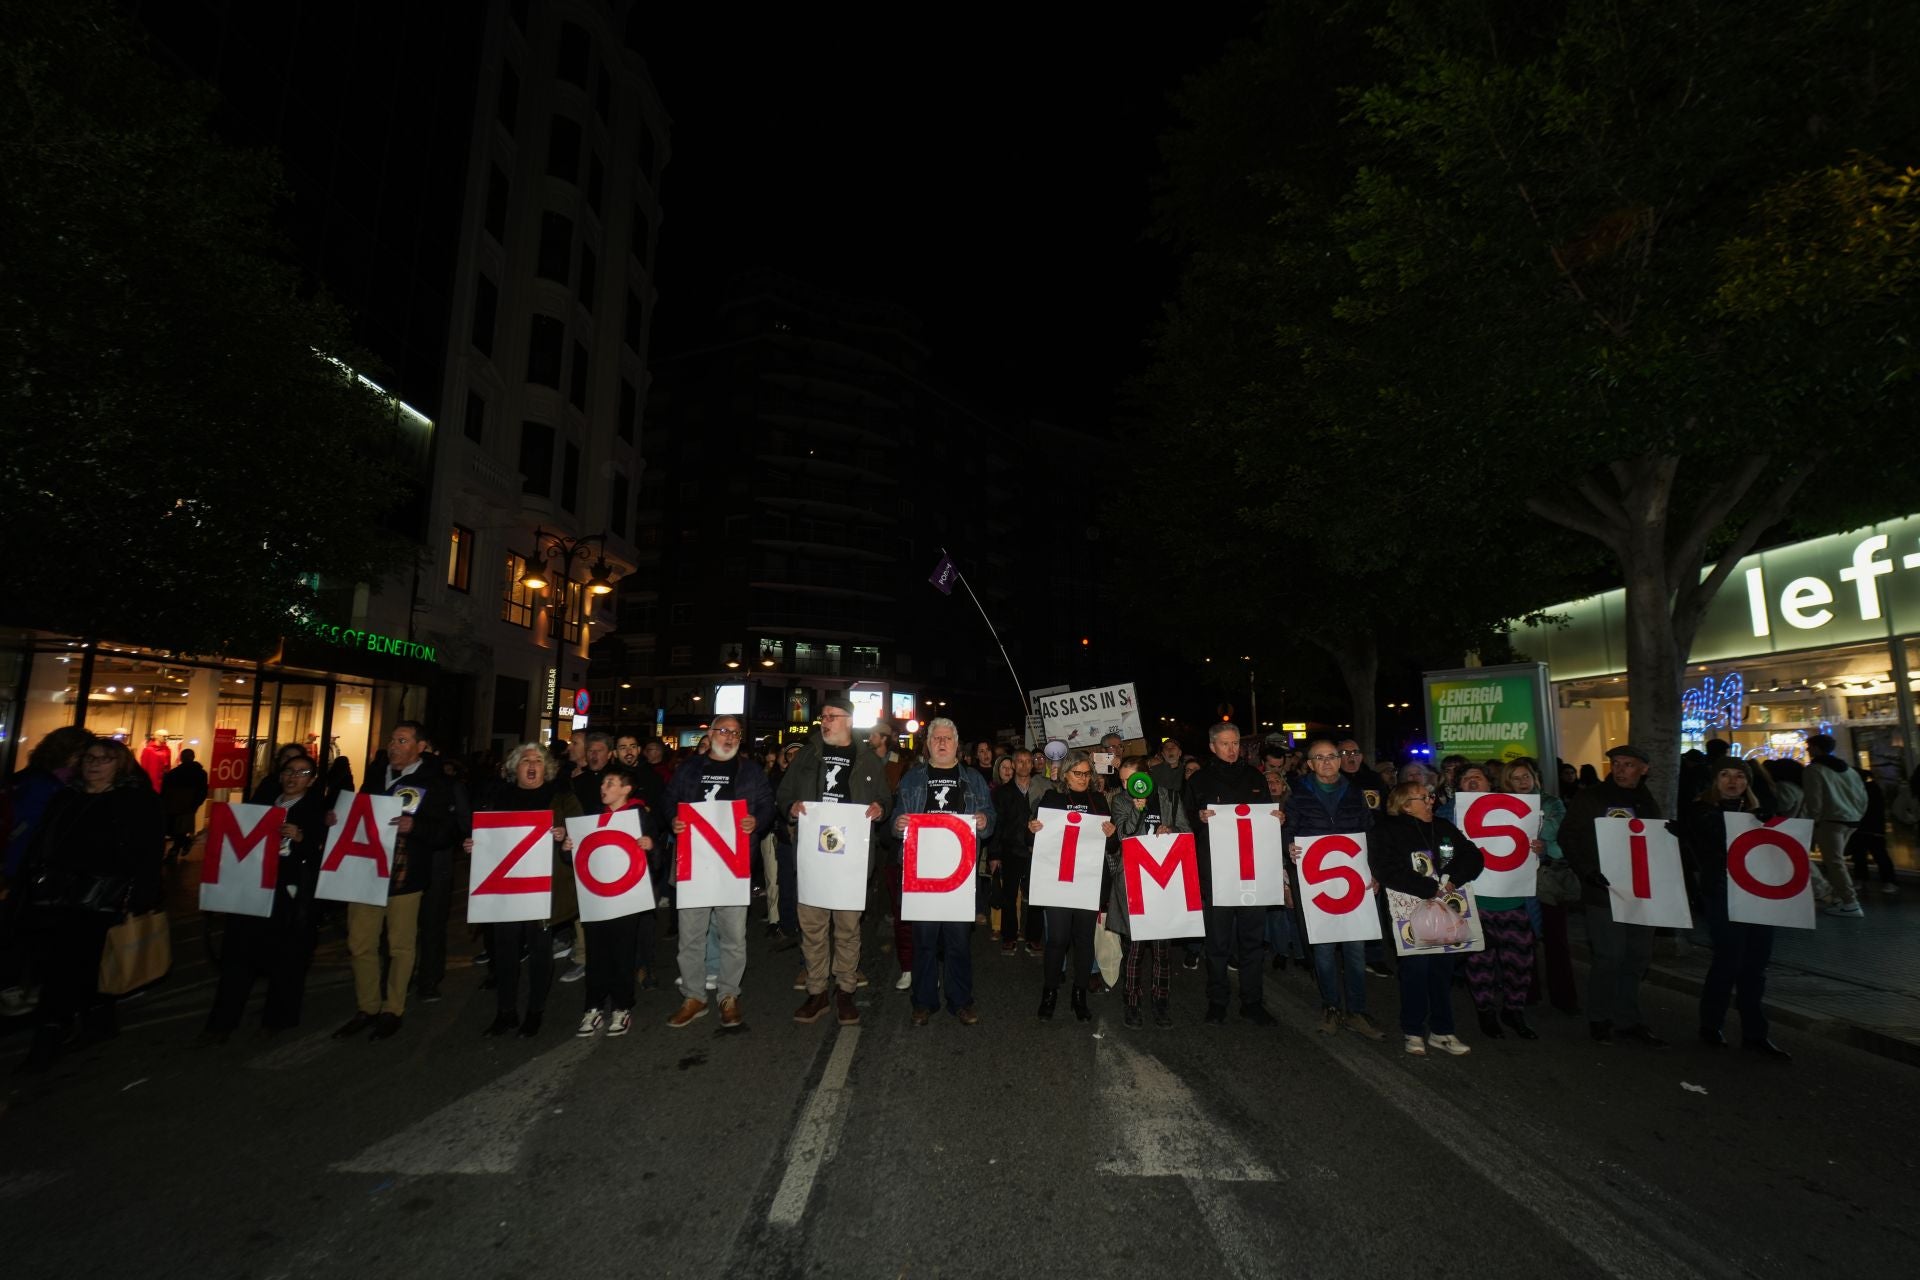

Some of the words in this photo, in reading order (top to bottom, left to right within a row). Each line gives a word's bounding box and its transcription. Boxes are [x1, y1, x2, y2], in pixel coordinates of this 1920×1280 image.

[546, 667, 558, 710] PULL&BEAR
[1438, 683, 1503, 707] ¿ENERGÍA
[1439, 705, 1483, 724] LIMPIA
[1484, 703, 1496, 723] Y
[789, 726, 809, 734] 19:32
